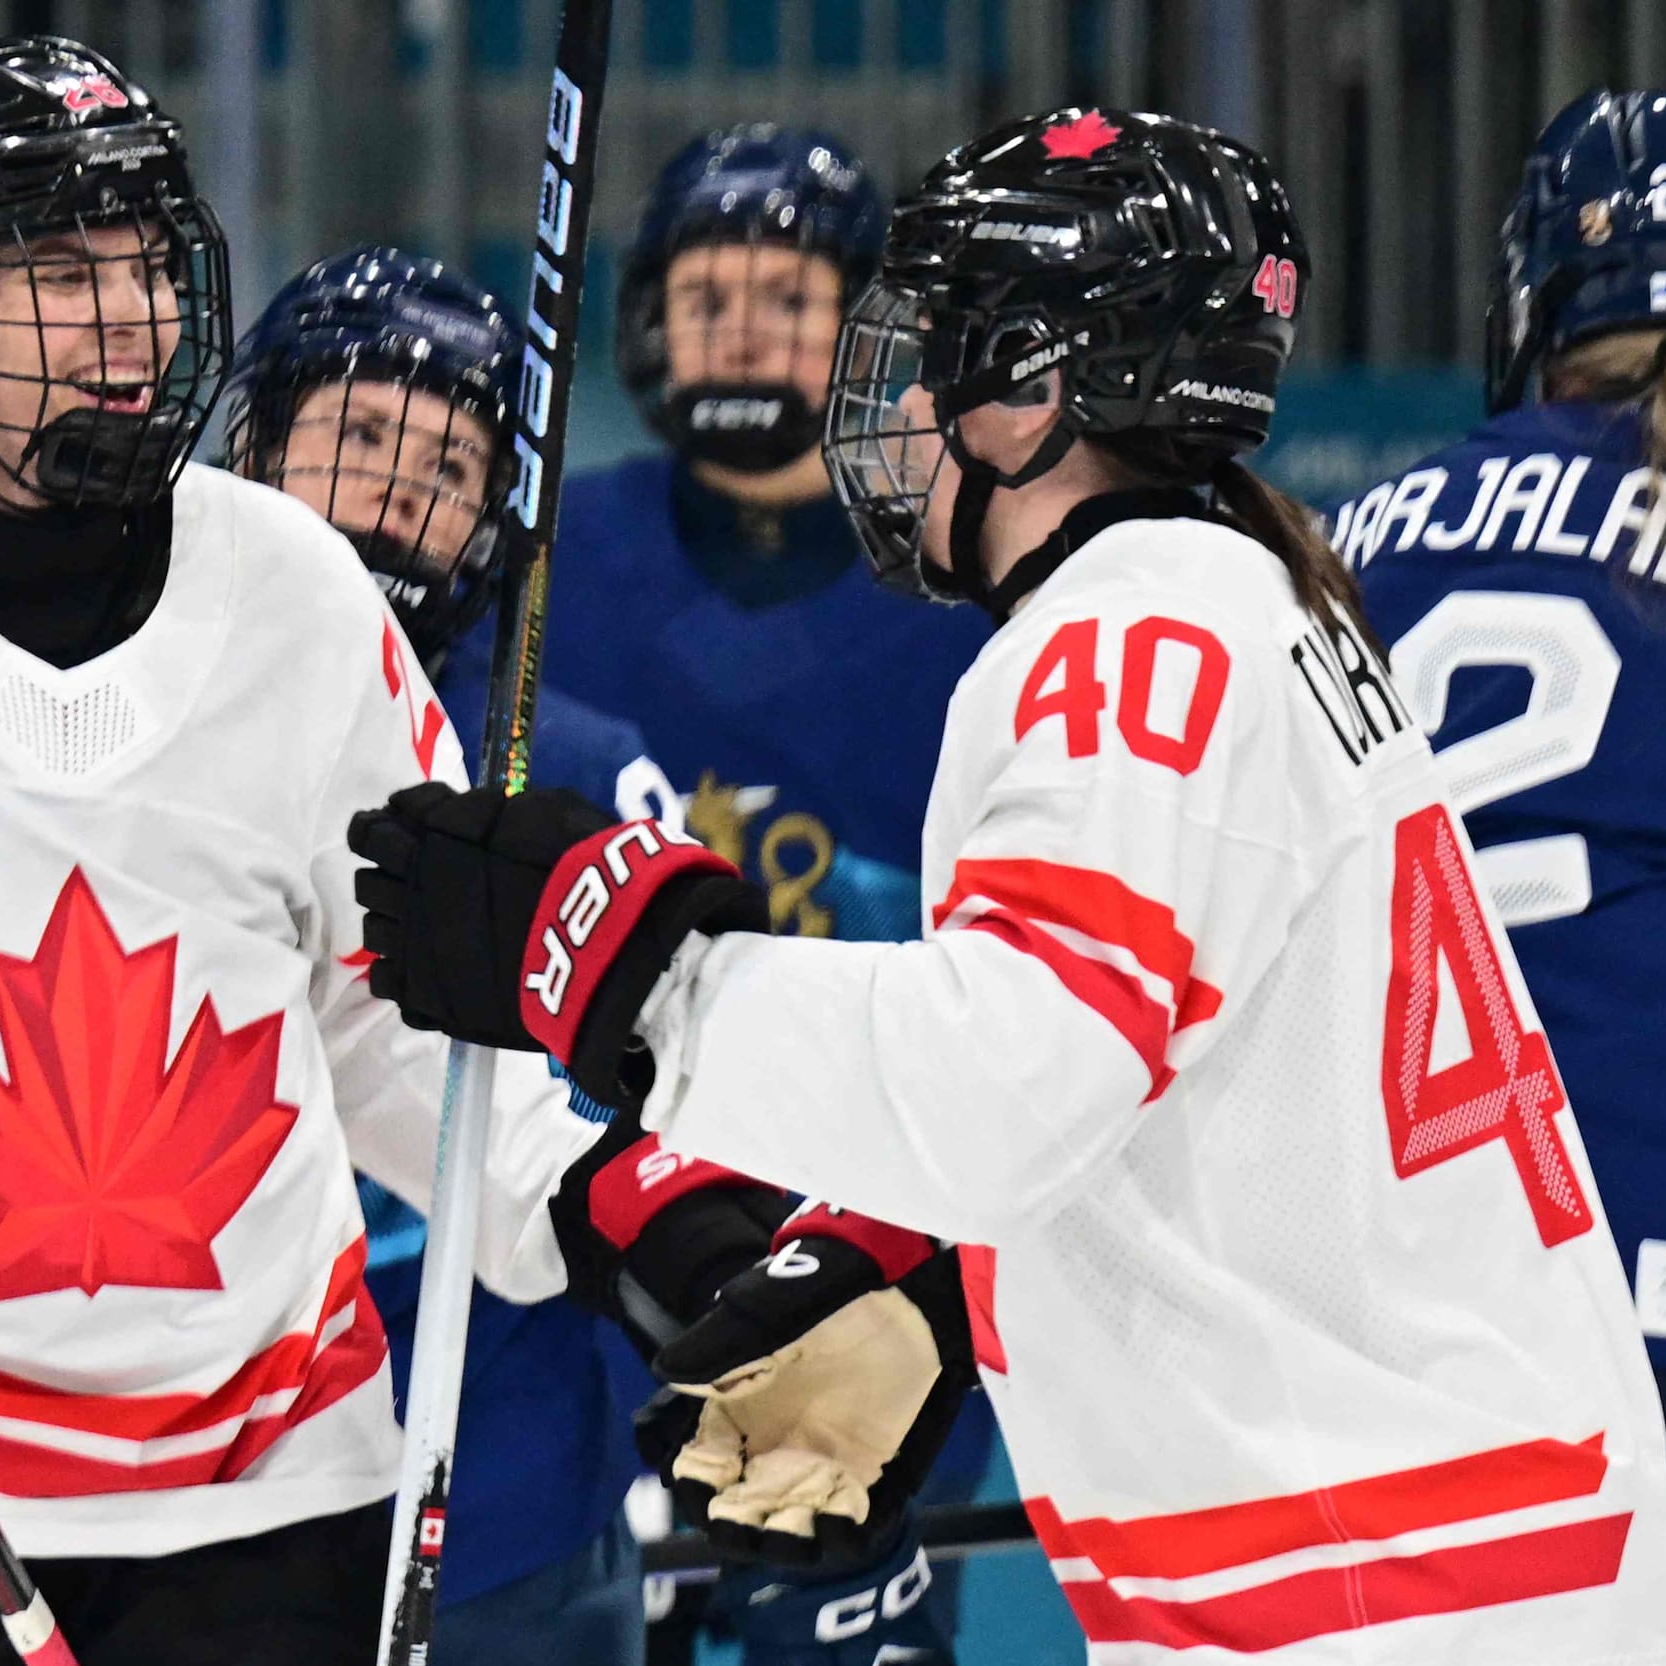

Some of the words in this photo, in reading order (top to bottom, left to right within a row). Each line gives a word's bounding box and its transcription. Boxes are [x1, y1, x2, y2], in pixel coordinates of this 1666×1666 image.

[508, 66, 583, 530] BAUER
[1252, 254, 1298, 318] 40
[1014, 615, 1231, 778] 40
[1388, 590, 1622, 927] 2
